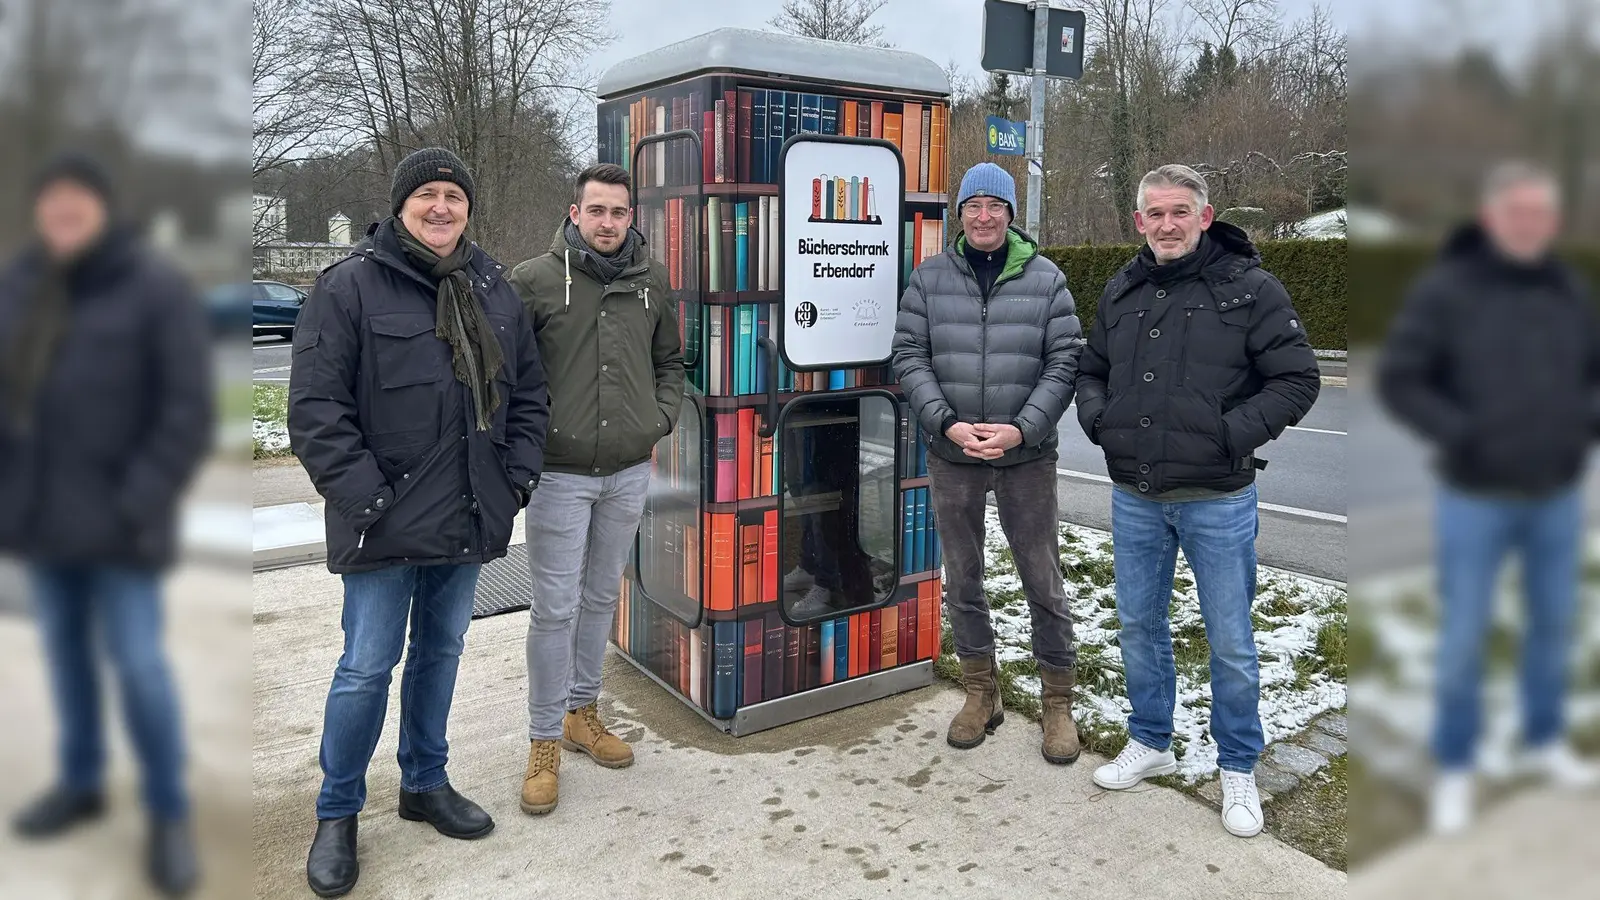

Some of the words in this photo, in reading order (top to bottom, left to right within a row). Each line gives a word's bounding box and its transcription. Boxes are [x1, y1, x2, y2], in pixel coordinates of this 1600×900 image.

[798, 238, 889, 256] Bücherschrank
[813, 263, 875, 278] Erbendorf
[797, 302, 811, 311] KU
[797, 312, 811, 320] KU
